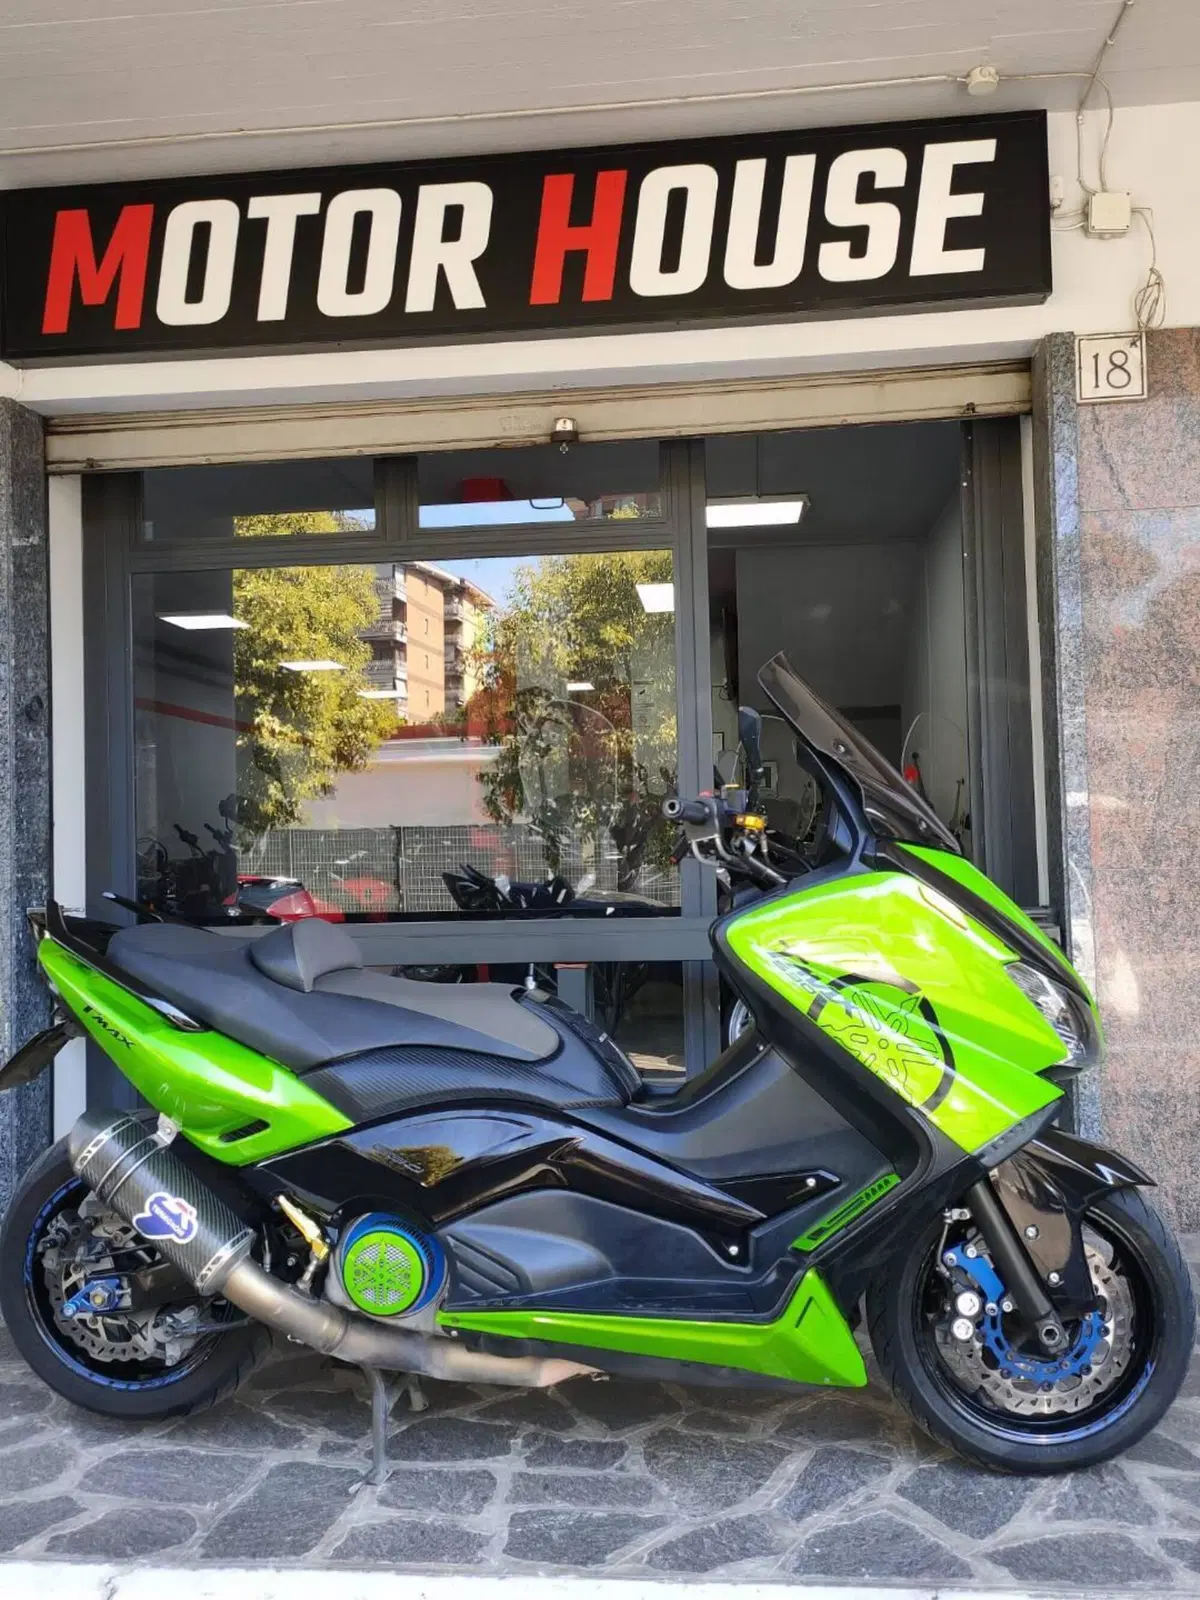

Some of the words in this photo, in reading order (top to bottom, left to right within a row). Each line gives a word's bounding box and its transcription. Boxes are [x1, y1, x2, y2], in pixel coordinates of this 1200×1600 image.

[41, 181, 494, 335] MOTOR
[529, 138, 997, 306] HOUSE
[1092, 349, 1132, 389] 18
